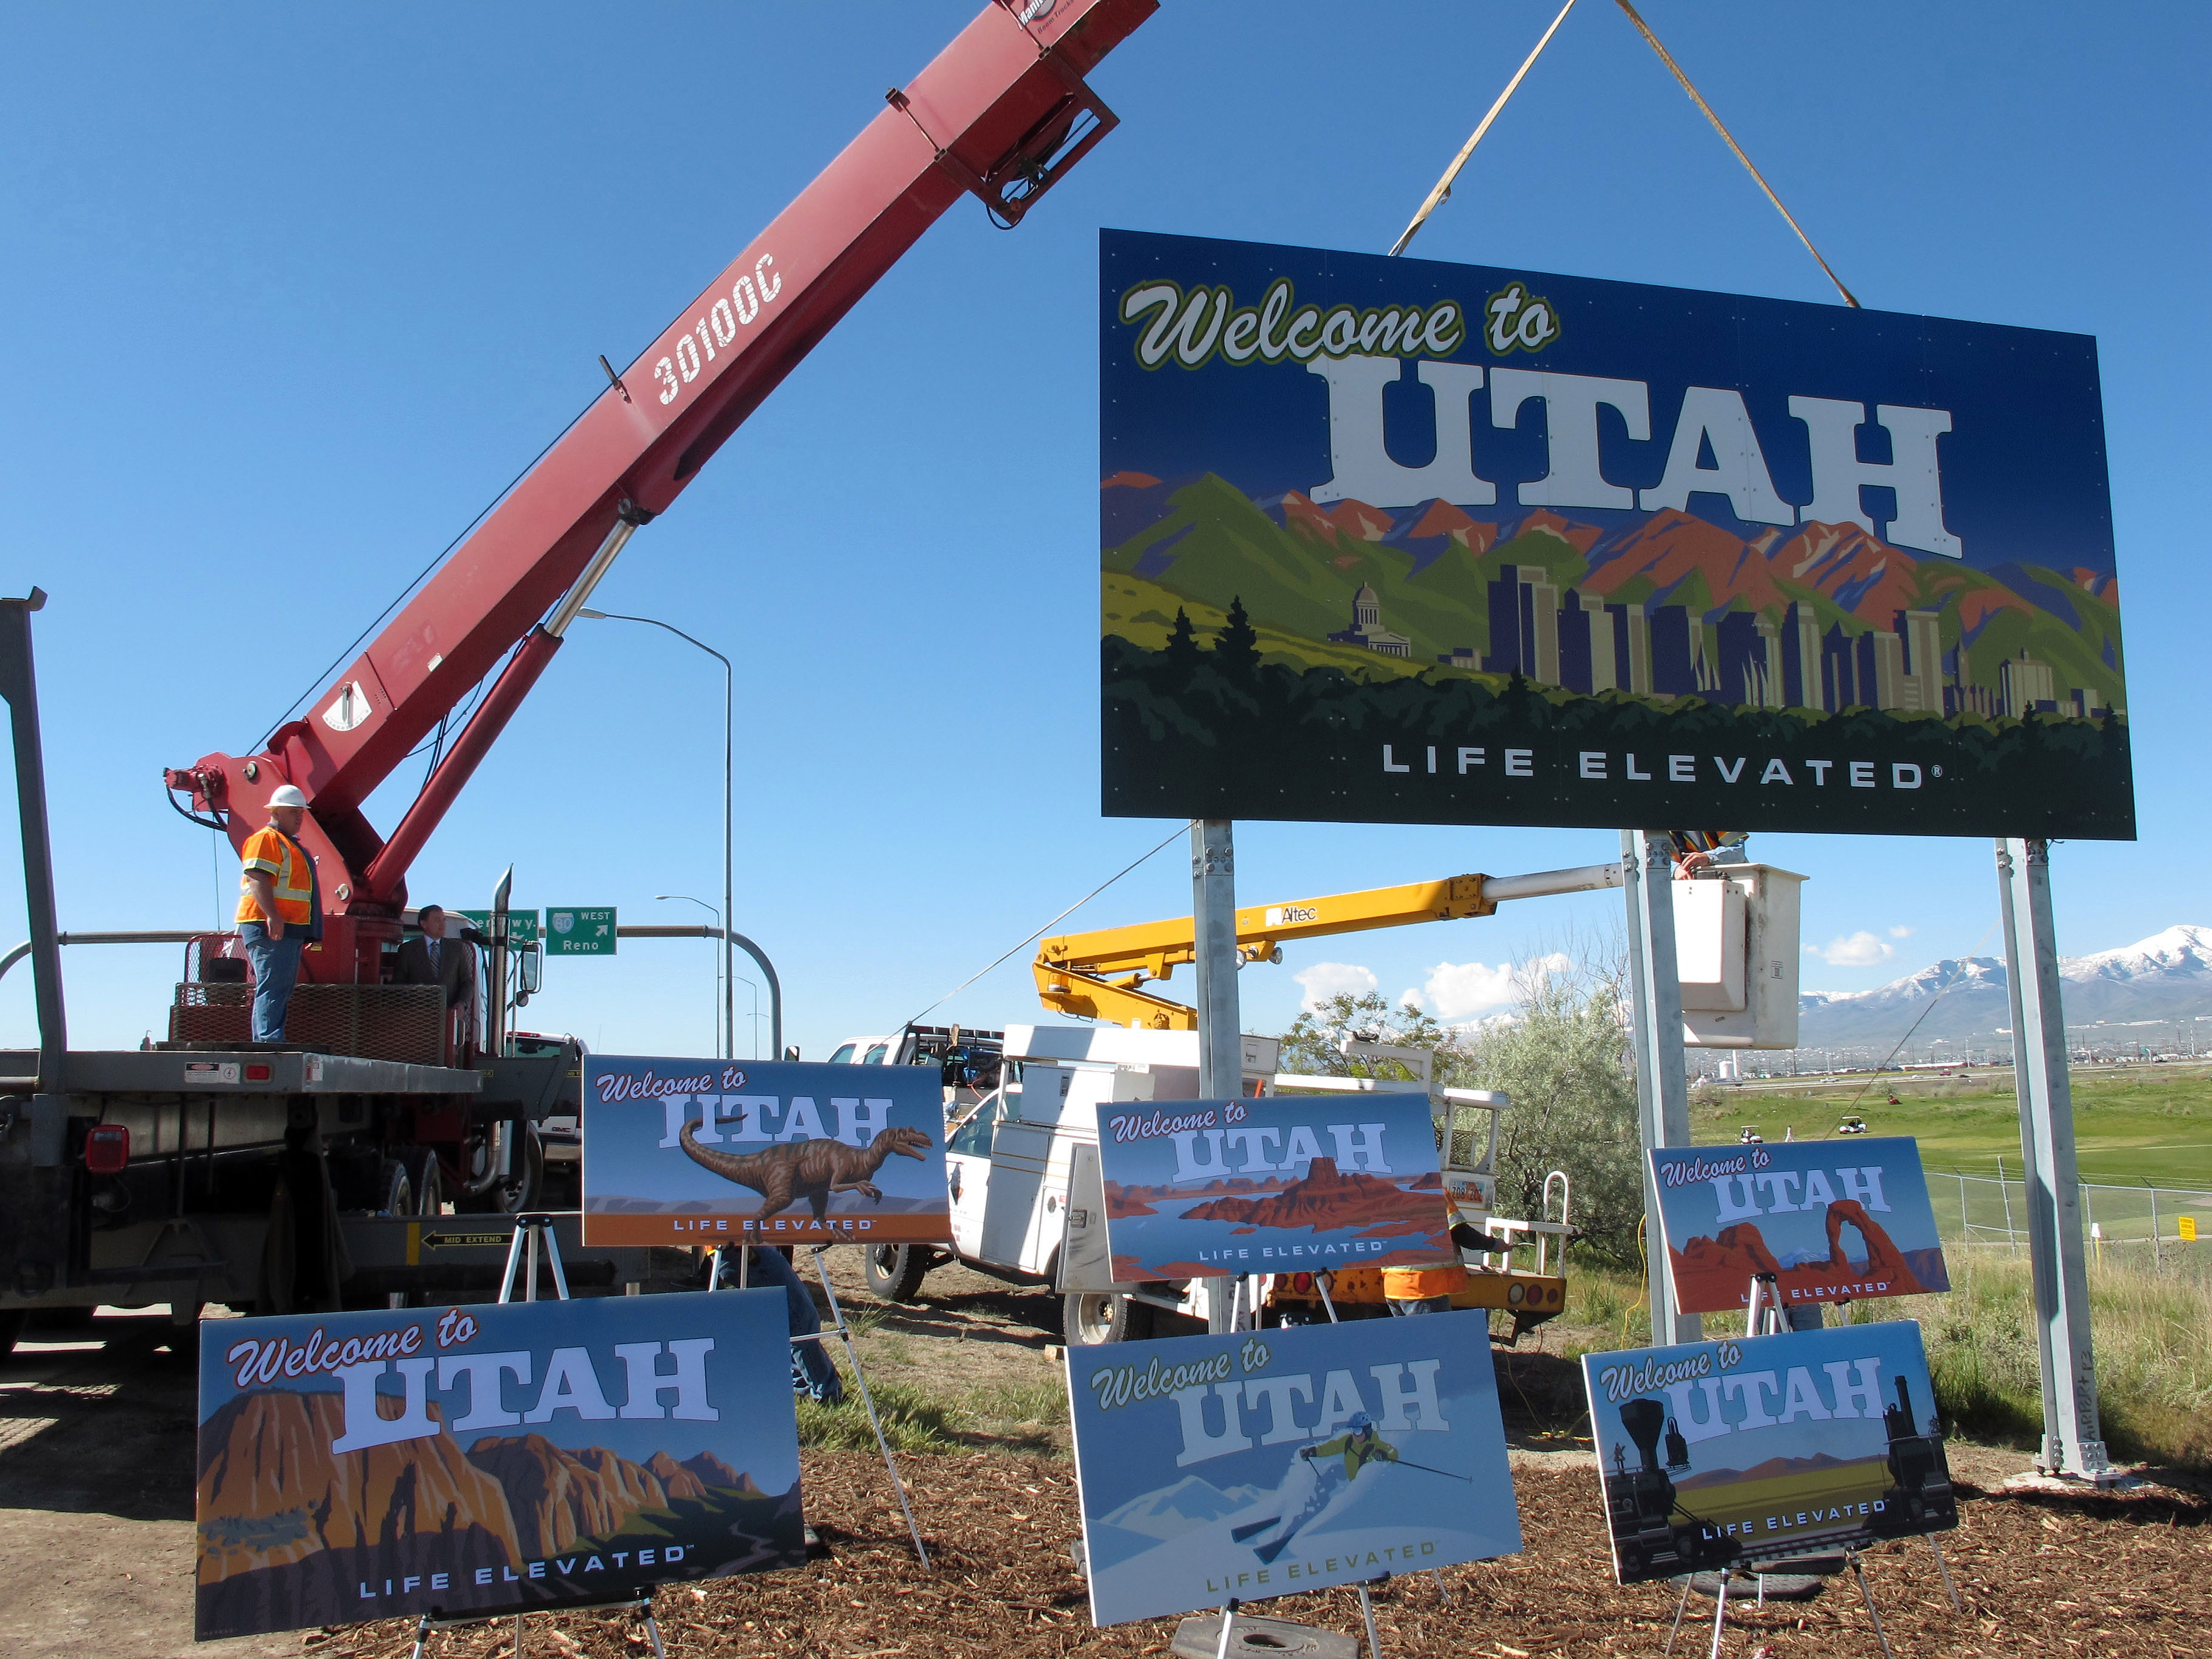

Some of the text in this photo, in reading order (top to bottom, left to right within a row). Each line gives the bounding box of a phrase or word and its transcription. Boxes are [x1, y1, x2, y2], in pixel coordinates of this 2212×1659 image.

[654, 253, 782, 405] 30100C
[1124, 282, 1555, 366] Welcome to
[1307, 354, 1963, 559] UTAH
[1382, 744, 1534, 777] LIFE
[554, 911, 611, 929] 80 WEST
[1281, 907, 1316, 923] Altec
[563, 940, 599, 950] Reno
[597, 1066, 747, 1102] Welcome to
[658, 1094, 894, 1149] UTAH
[1110, 1101, 1247, 1142] Welcome to
[1169, 1123, 1393, 1183] UTAH
[1660, 1147, 1770, 1187] Welcome to
[1708, 1166, 1892, 1224] UTAH
[674, 1220, 872, 1231] LIFE ELEVATED
[1199, 1241, 1382, 1262] LIFE ELEVATED
[1792, 1281, 1888, 1298] ELEVATED
[228, 1309, 478, 1387] Welcome to
[1092, 1338, 1270, 1408] Welcome to
[1601, 1340, 1742, 1402] Welcome to
[332, 1338, 720, 1455] UTAH
[1169, 1359, 1450, 1467] UTAH
[1662, 1357, 1885, 1445] UTAH
[1702, 1499, 1886, 1540] LIFE ELEVATED
[360, 1545, 684, 1599] LIFE ELEVATED
[1206, 1541, 1435, 1592] LIFE ELEVATED
